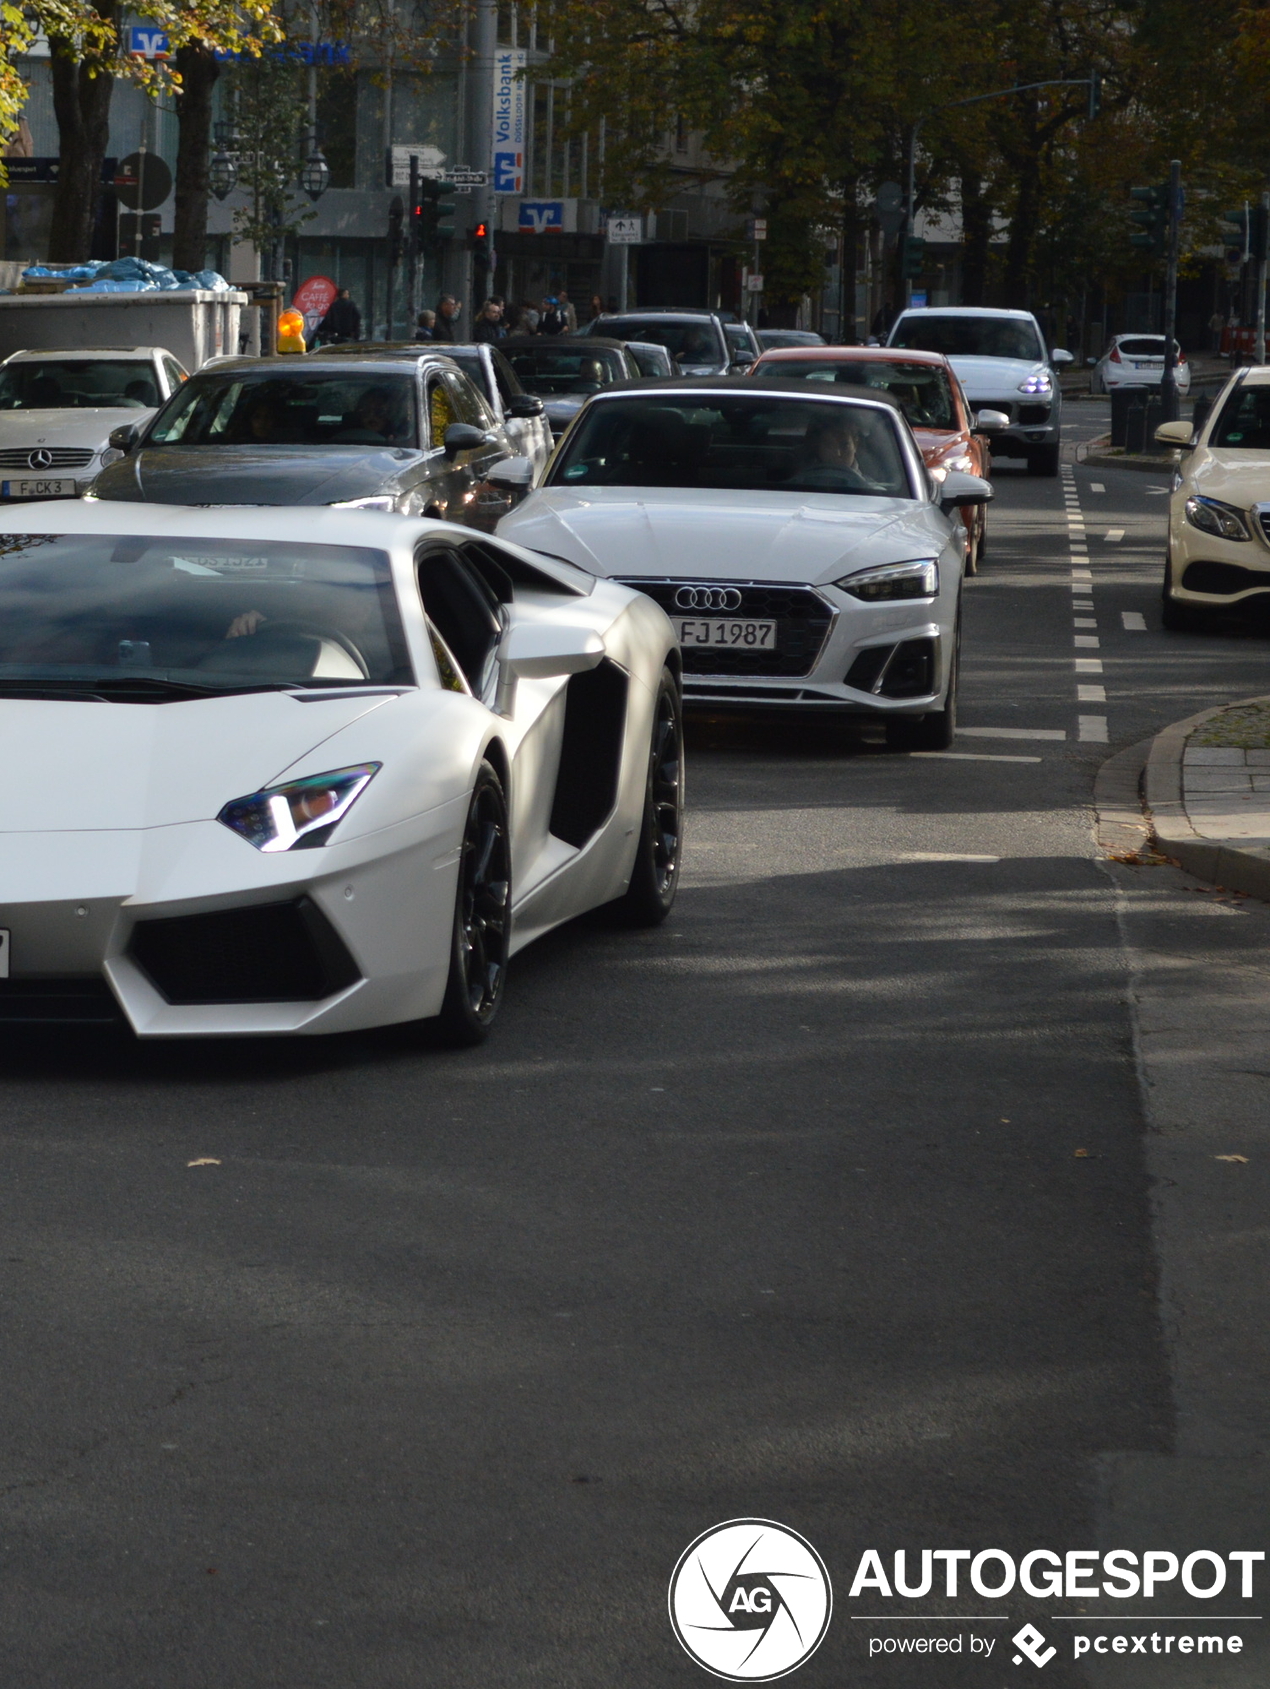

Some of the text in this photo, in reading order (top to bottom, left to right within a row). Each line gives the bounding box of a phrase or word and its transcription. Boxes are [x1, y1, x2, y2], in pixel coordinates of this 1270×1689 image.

[496, 53, 513, 143] Volksbank
[20, 481, 62, 495] F CK 3
[680, 621, 772, 646] FJ 1987
